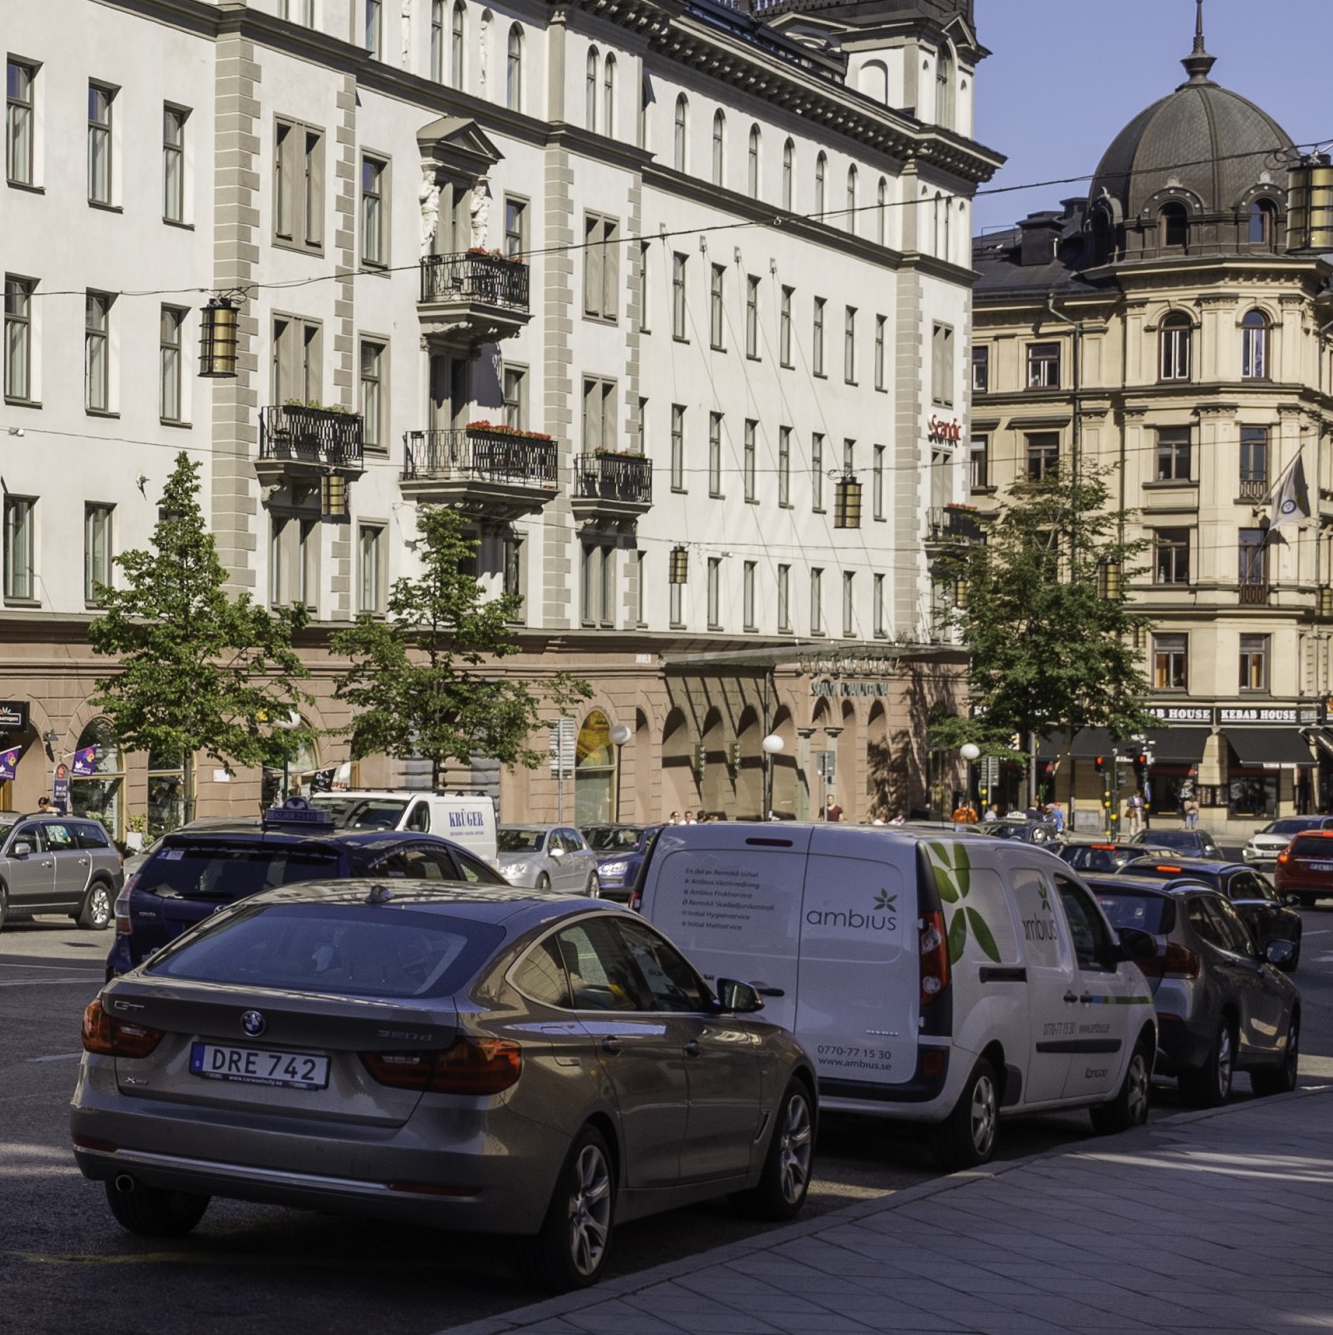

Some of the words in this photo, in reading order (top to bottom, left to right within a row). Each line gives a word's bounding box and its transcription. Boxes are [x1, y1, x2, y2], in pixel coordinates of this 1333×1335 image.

[932, 414, 961, 440] Scandic
[1169, 709, 1211, 719] HOUSE
[1221, 709, 1257, 720] KEBAB
[1260, 709, 1296, 720] HOUSE
[449, 808, 483, 827] KRÜGER
[806, 909, 897, 931] ambius
[817, 1045, 860, 1057] 0770-77
[863, 1049, 875, 1058] 15
[878, 1050, 891, 1060] 30
[211, 1048, 259, 1075] DRE
[268, 1054, 317, 1081] 742
[818, 1057, 892, 1071] www.ambius.se
